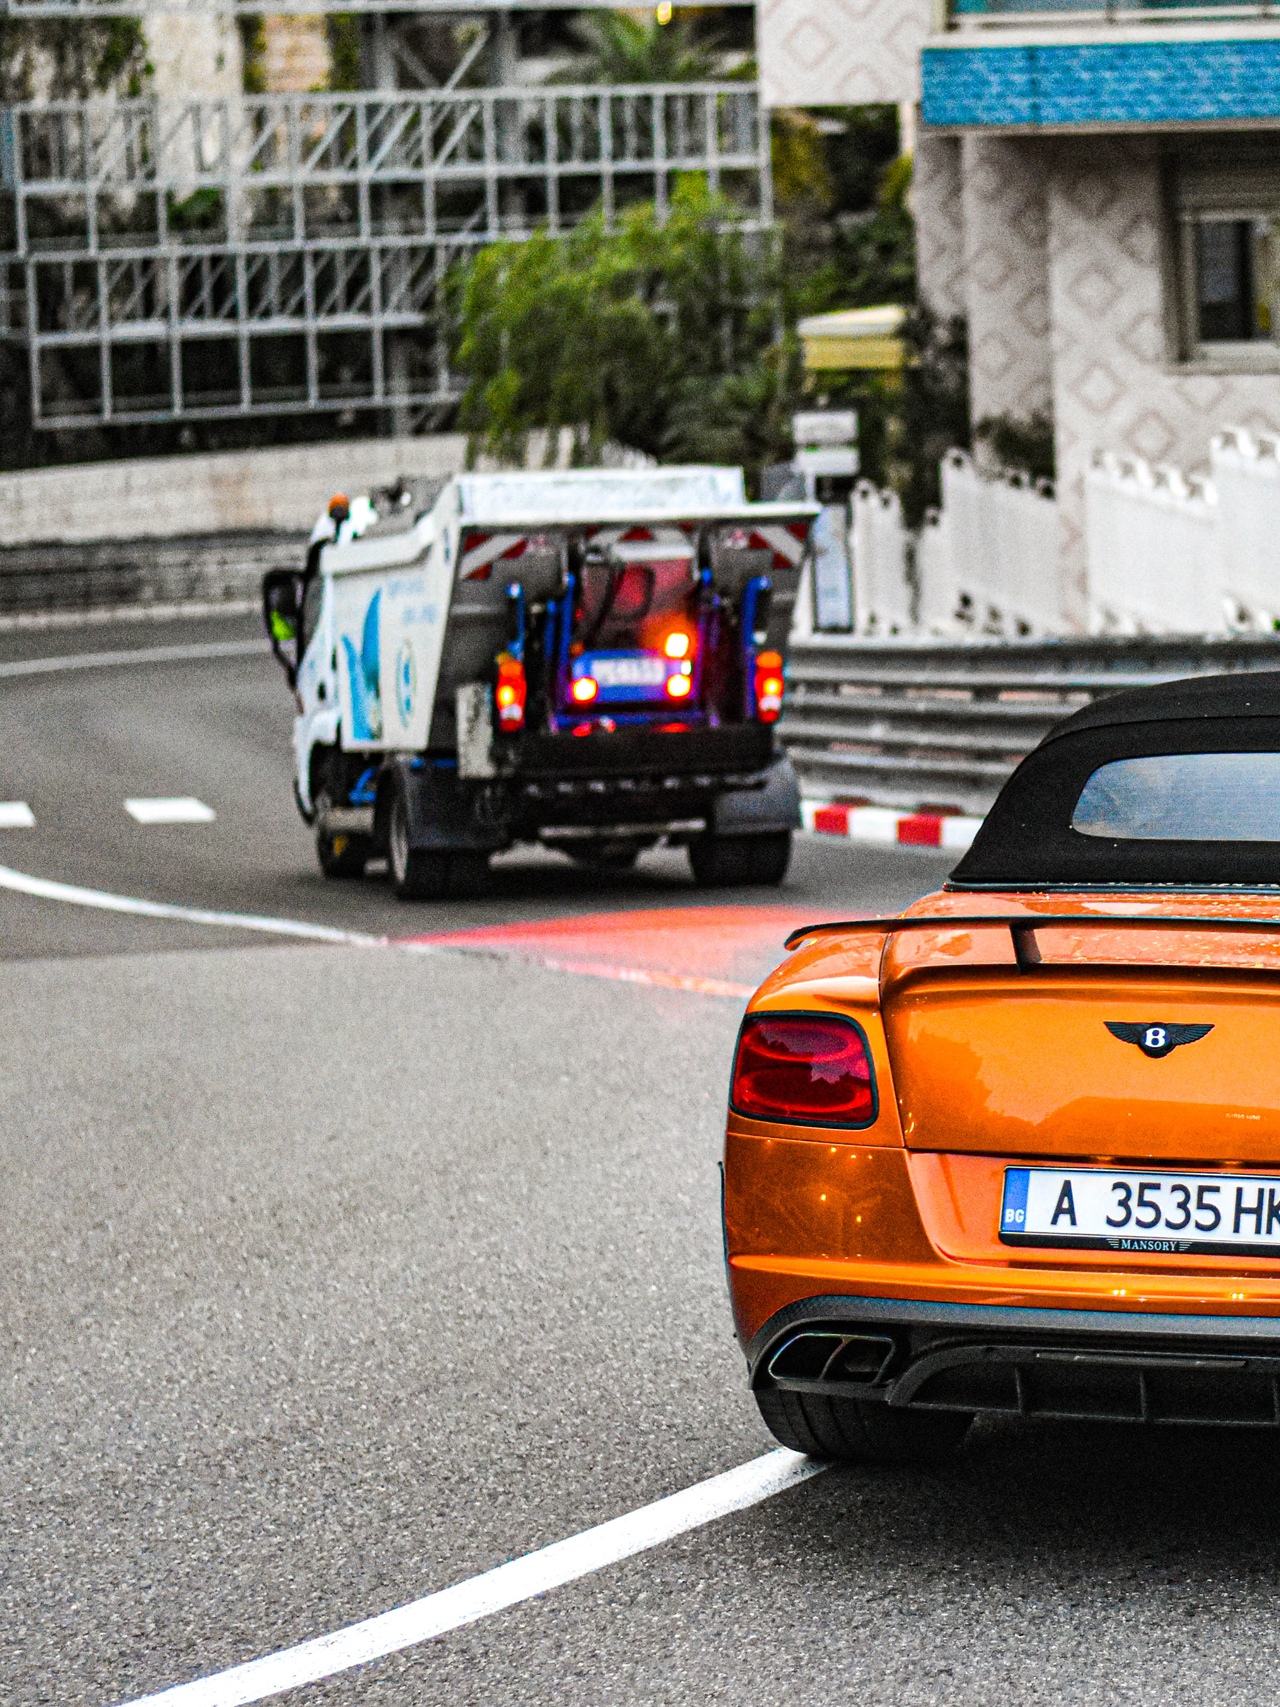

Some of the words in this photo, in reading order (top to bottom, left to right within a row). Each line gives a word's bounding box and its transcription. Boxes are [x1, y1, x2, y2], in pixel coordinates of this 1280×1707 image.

[1144, 1027, 1166, 1048] B
[1050, 1179, 1077, 1226] A
[1105, 1181, 1221, 1232] 3535
[1004, 1208, 1025, 1223] BG
[1120, 1238, 1178, 1252] MANSORY
